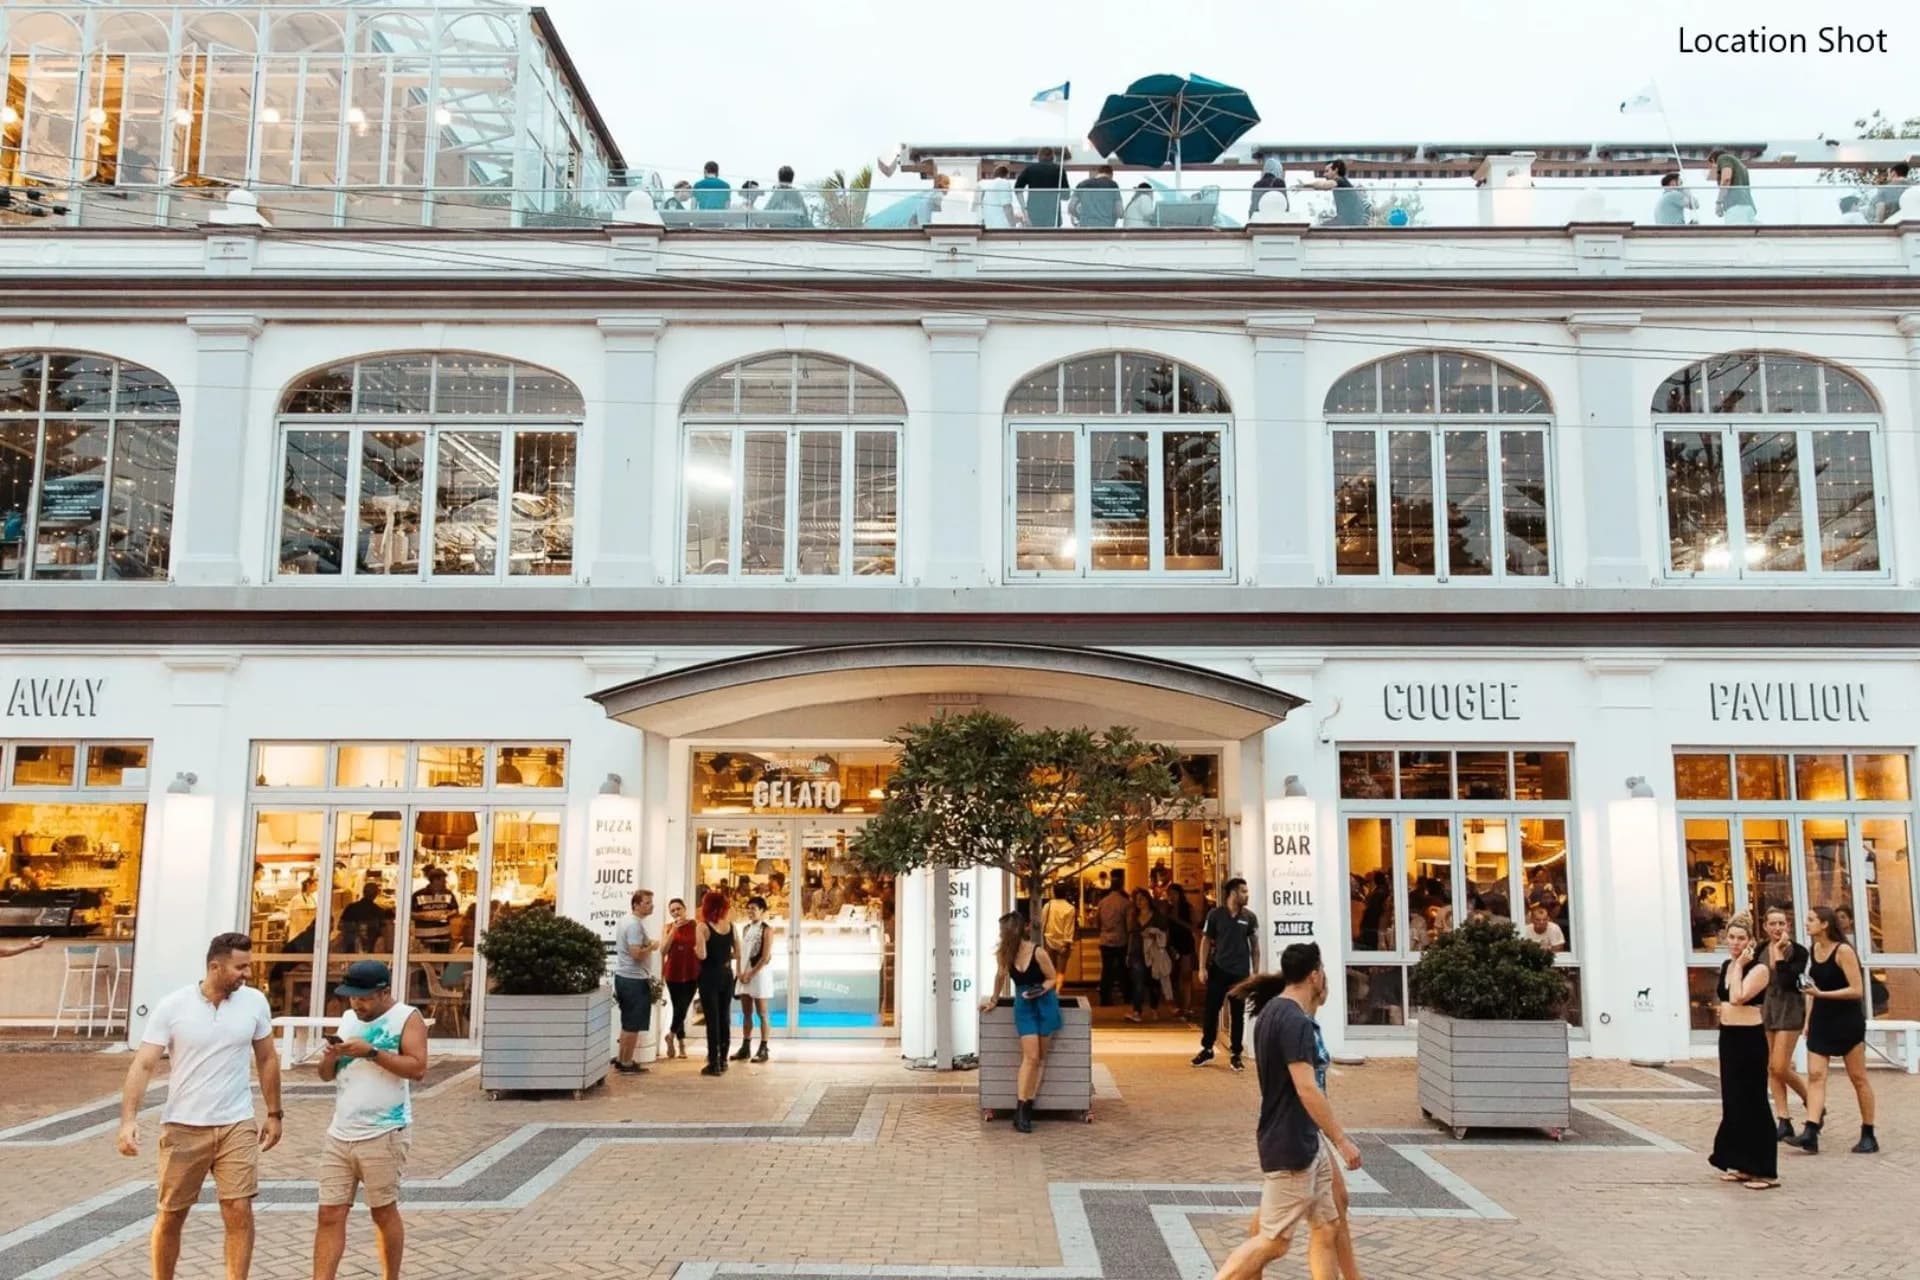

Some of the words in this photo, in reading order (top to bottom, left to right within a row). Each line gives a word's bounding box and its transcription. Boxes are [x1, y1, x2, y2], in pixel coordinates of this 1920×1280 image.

[6, 677, 106, 717] AWAY
[1384, 680, 1521, 721] COOGEE
[1710, 681, 1872, 722] PAVILION
[752, 780, 841, 809] GELATO
[596, 819, 633, 833] PIZZA
[1273, 834, 1311, 856] BAR
[594, 868, 633, 884] JUICE
[949, 881, 970, 898] SH
[1272, 890, 1313, 906] GRILL
[590, 910, 610, 922] PING
[949, 906, 970, 919] IPS
[1277, 922, 1311, 935] GAMES
